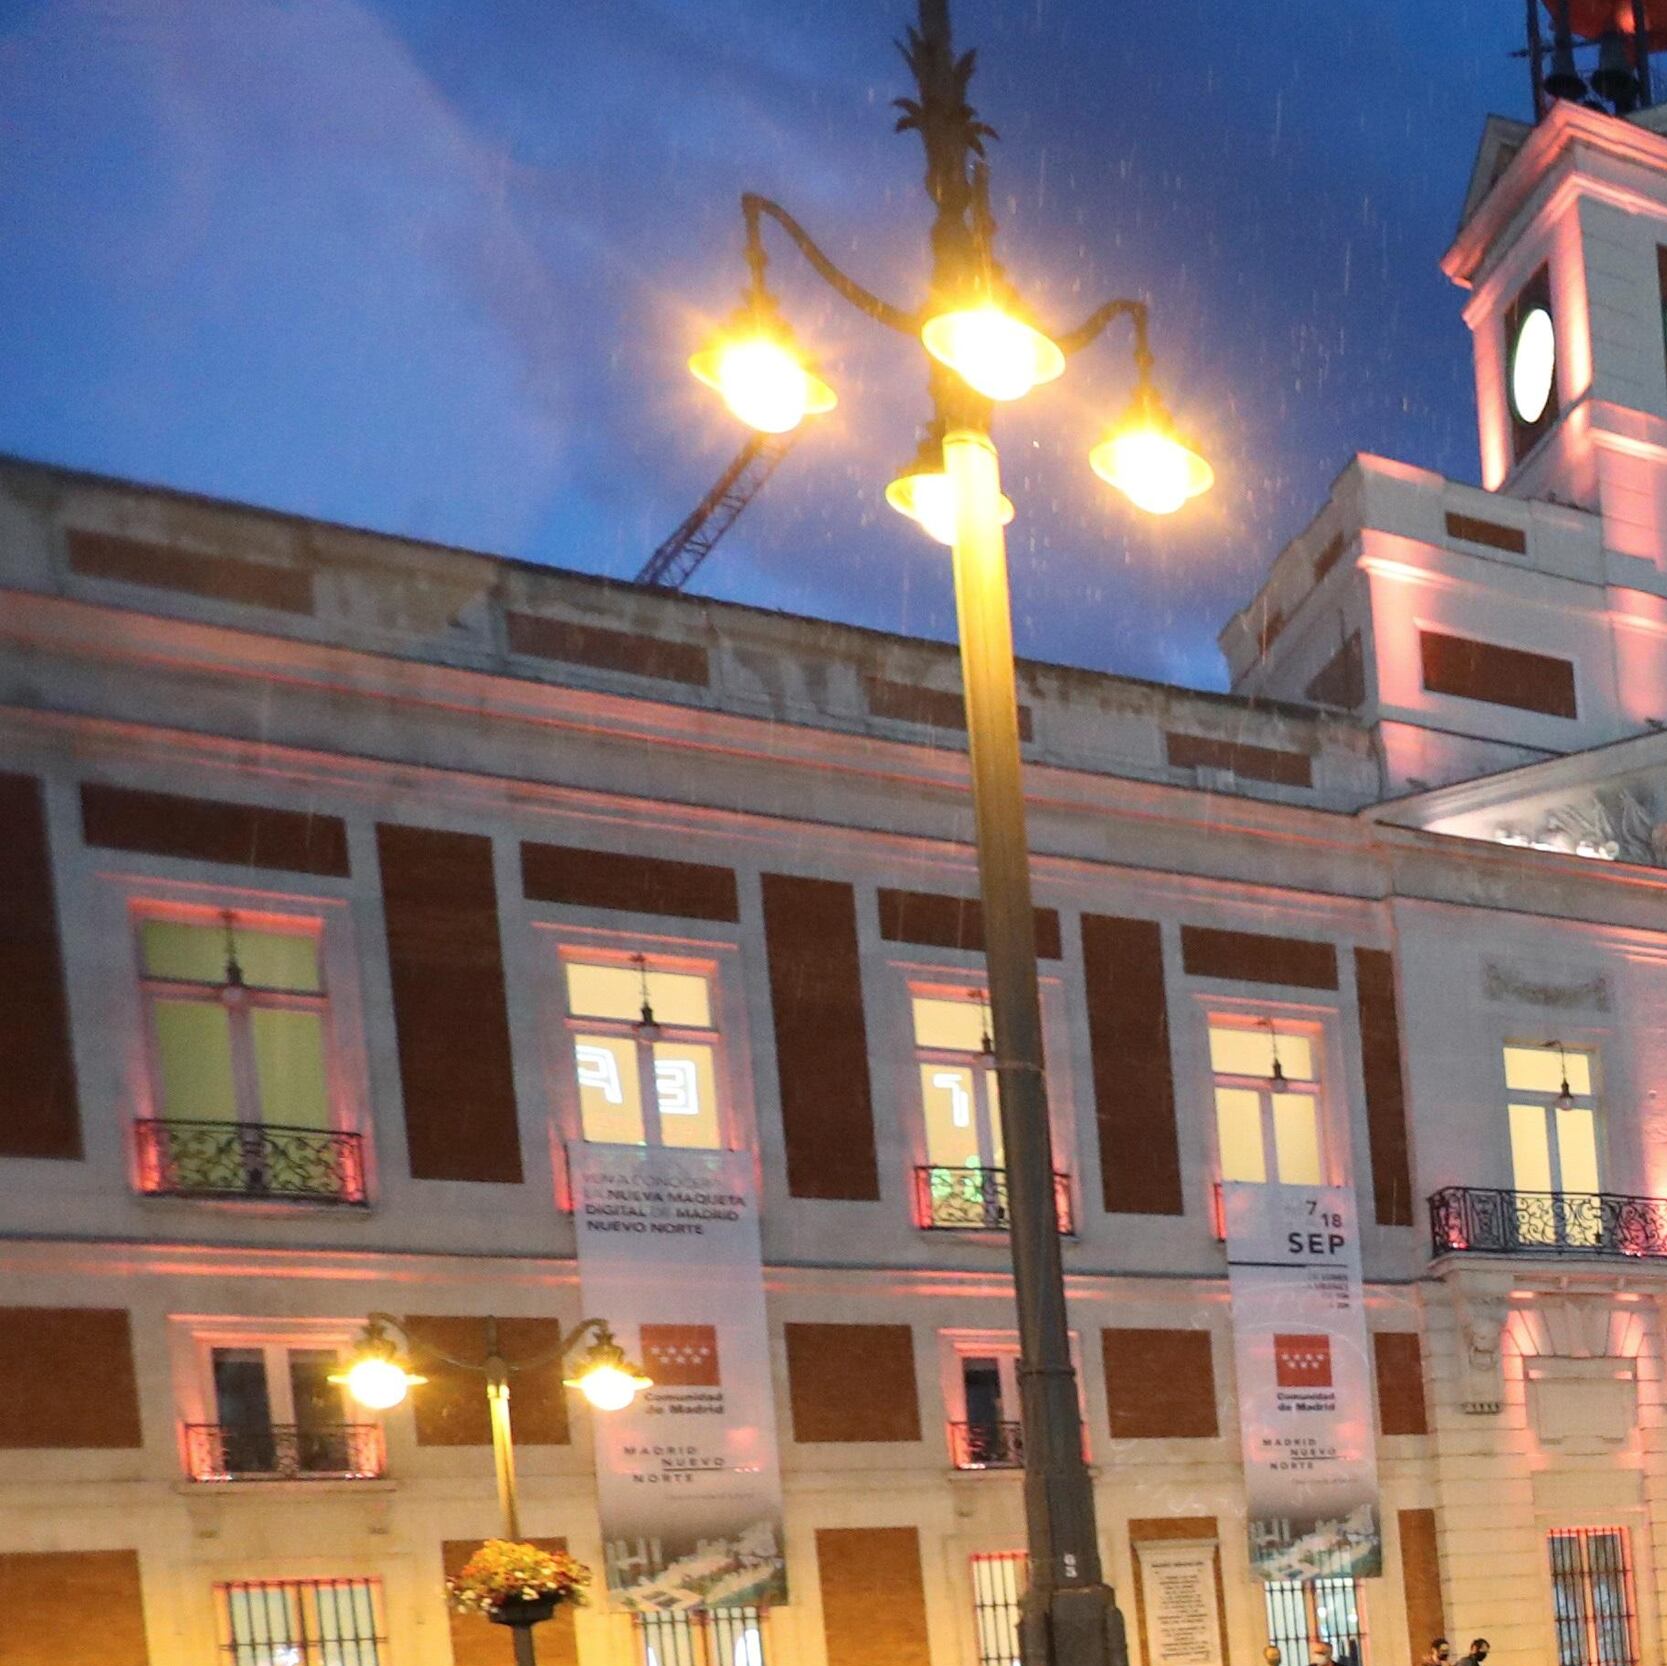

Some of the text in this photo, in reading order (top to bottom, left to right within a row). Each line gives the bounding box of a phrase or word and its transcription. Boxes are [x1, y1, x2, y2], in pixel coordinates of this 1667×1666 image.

[608, 1189, 665, 1202] NUEVA
[668, 1192, 746, 1207] MAQUETA
[585, 1203, 647, 1217] DIGITAL
[675, 1208, 740, 1222] MADRID
[1305, 1199, 1318, 1216] 7
[1321, 1212, 1343, 1229] 18
[587, 1219, 705, 1236] NUEVO NORTE
[1288, 1231, 1346, 1255] SEP
[643, 1392, 724, 1402] Comunidad
[1277, 1392, 1336, 1401] Comunidad
[645, 1404, 725, 1415] de Madrid
[1277, 1402, 1336, 1412] de Madrid
[1262, 1438, 1316, 1447] MADRID
[624, 1446, 698, 1456] MADRID
[1290, 1447, 1337, 1457] NUEVO
[660, 1456, 726, 1467] NUEVO
[1270, 1461, 1314, 1470] NORTE
[633, 1473, 693, 1483] NORTE
